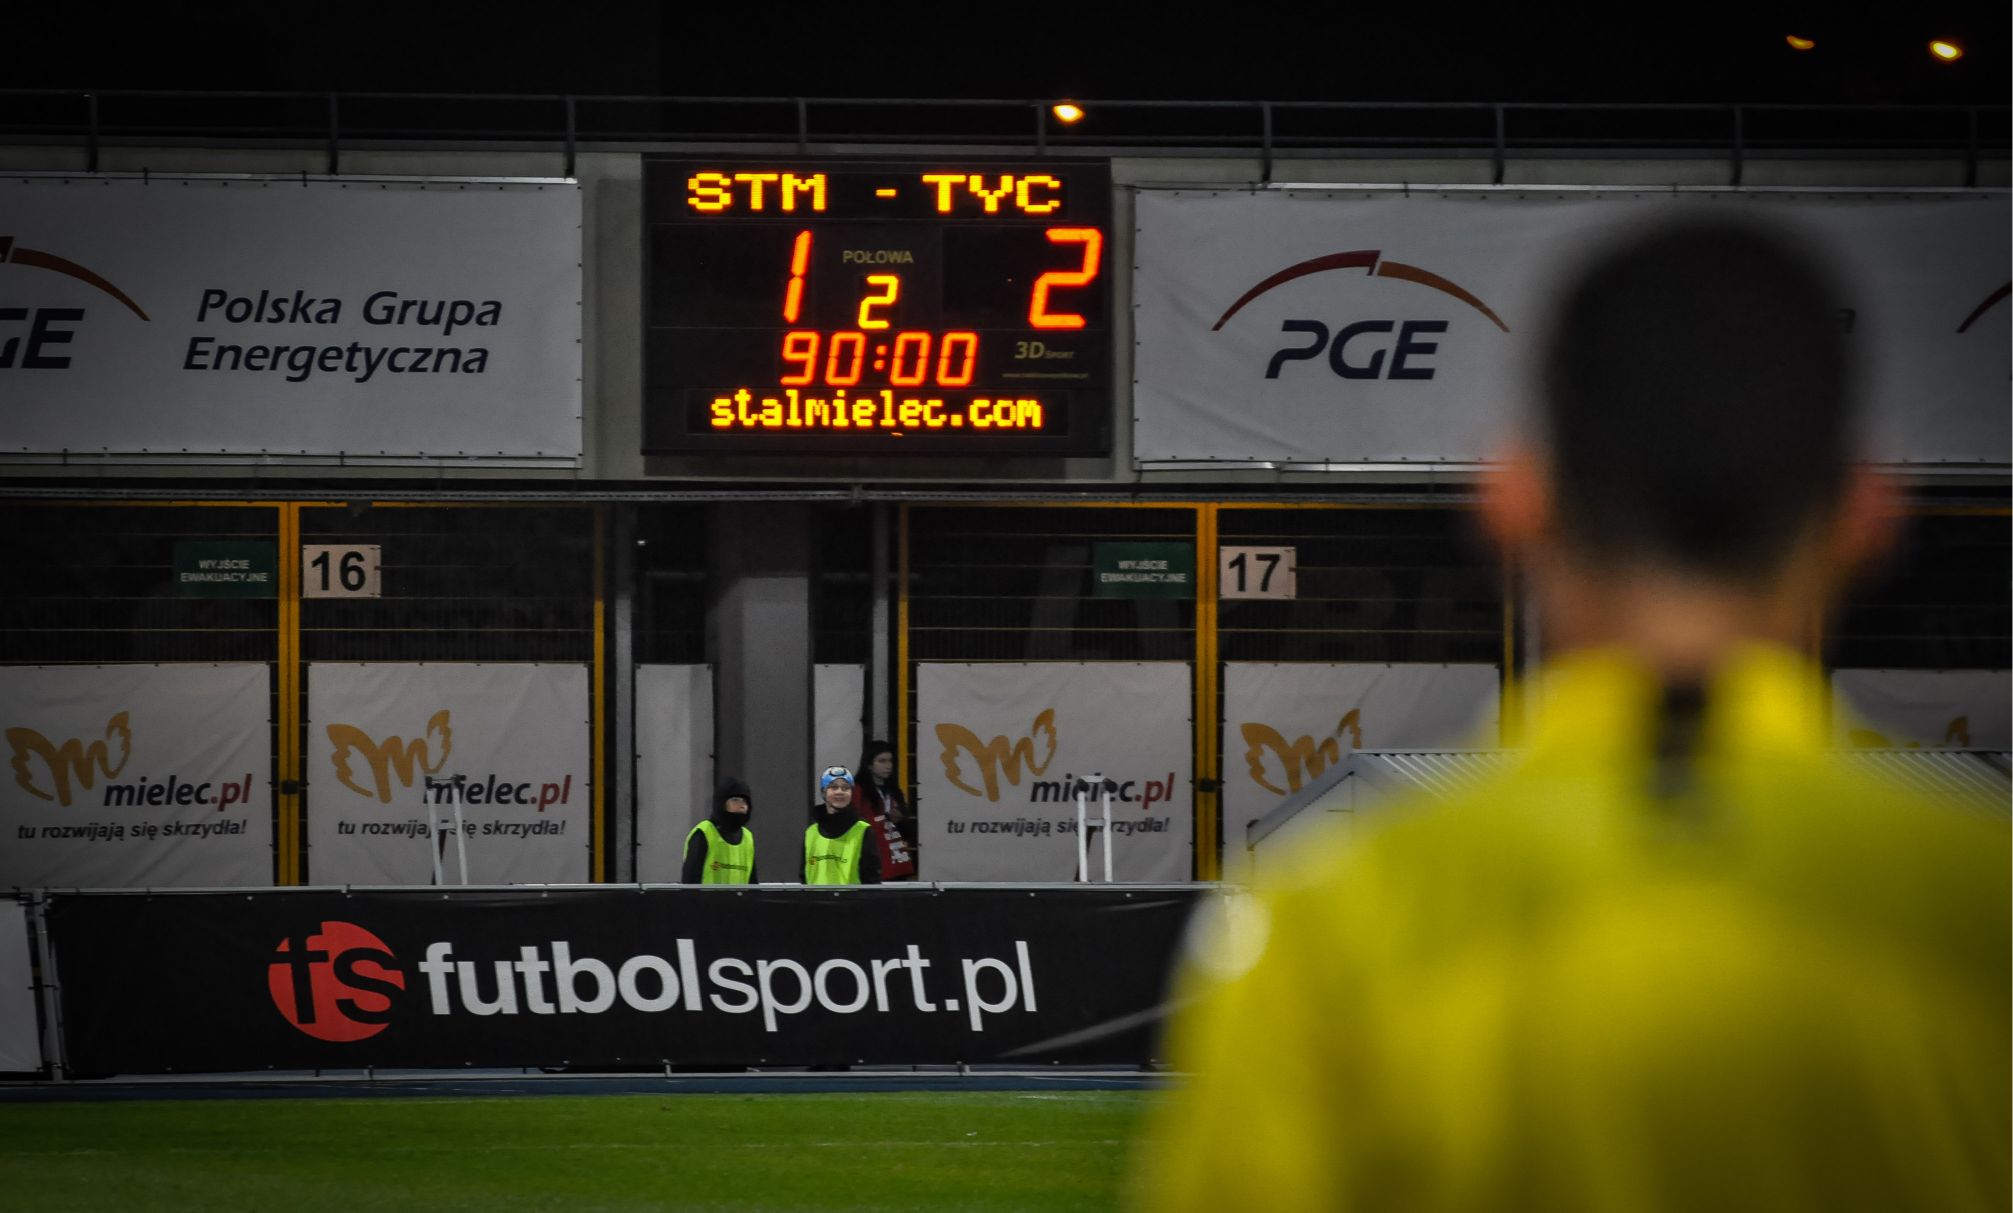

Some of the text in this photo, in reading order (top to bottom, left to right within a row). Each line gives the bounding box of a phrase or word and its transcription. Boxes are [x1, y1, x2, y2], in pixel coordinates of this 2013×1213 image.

[687, 172, 827, 213] STM
[921, 172, 1062, 215] TYC
[782, 229, 814, 324] 1
[842, 250, 914, 264] POŁOWA
[1027, 226, 1104, 331] 2
[197, 288, 502, 336] Polska Grupa
[857, 273, 900, 330] 2
[182, 337, 489, 384] Energetyczna
[779, 330, 980, 387] 90:00
[1014, 341, 1046, 359] 3D
[1265, 319, 1449, 381] PGE
[710, 389, 1043, 429] stalmielec.com
[180, 572, 268, 583] EWAKUACYJNE
[198, 558, 250, 570] WYJŚCIE
[311, 550, 366, 592] 16
[1228, 552, 1281, 593] 17
[103, 774, 252, 812] mielec.pl
[17, 819, 248, 842] tu rozwijają się skrzydła!
[337, 820, 356, 835] tu
[482, 819, 566, 840] skrzydła!
[947, 819, 966, 834] tu
[970, 817, 1051, 838] rozwijają
[418, 938, 1037, 1032] futbolsport.pl
